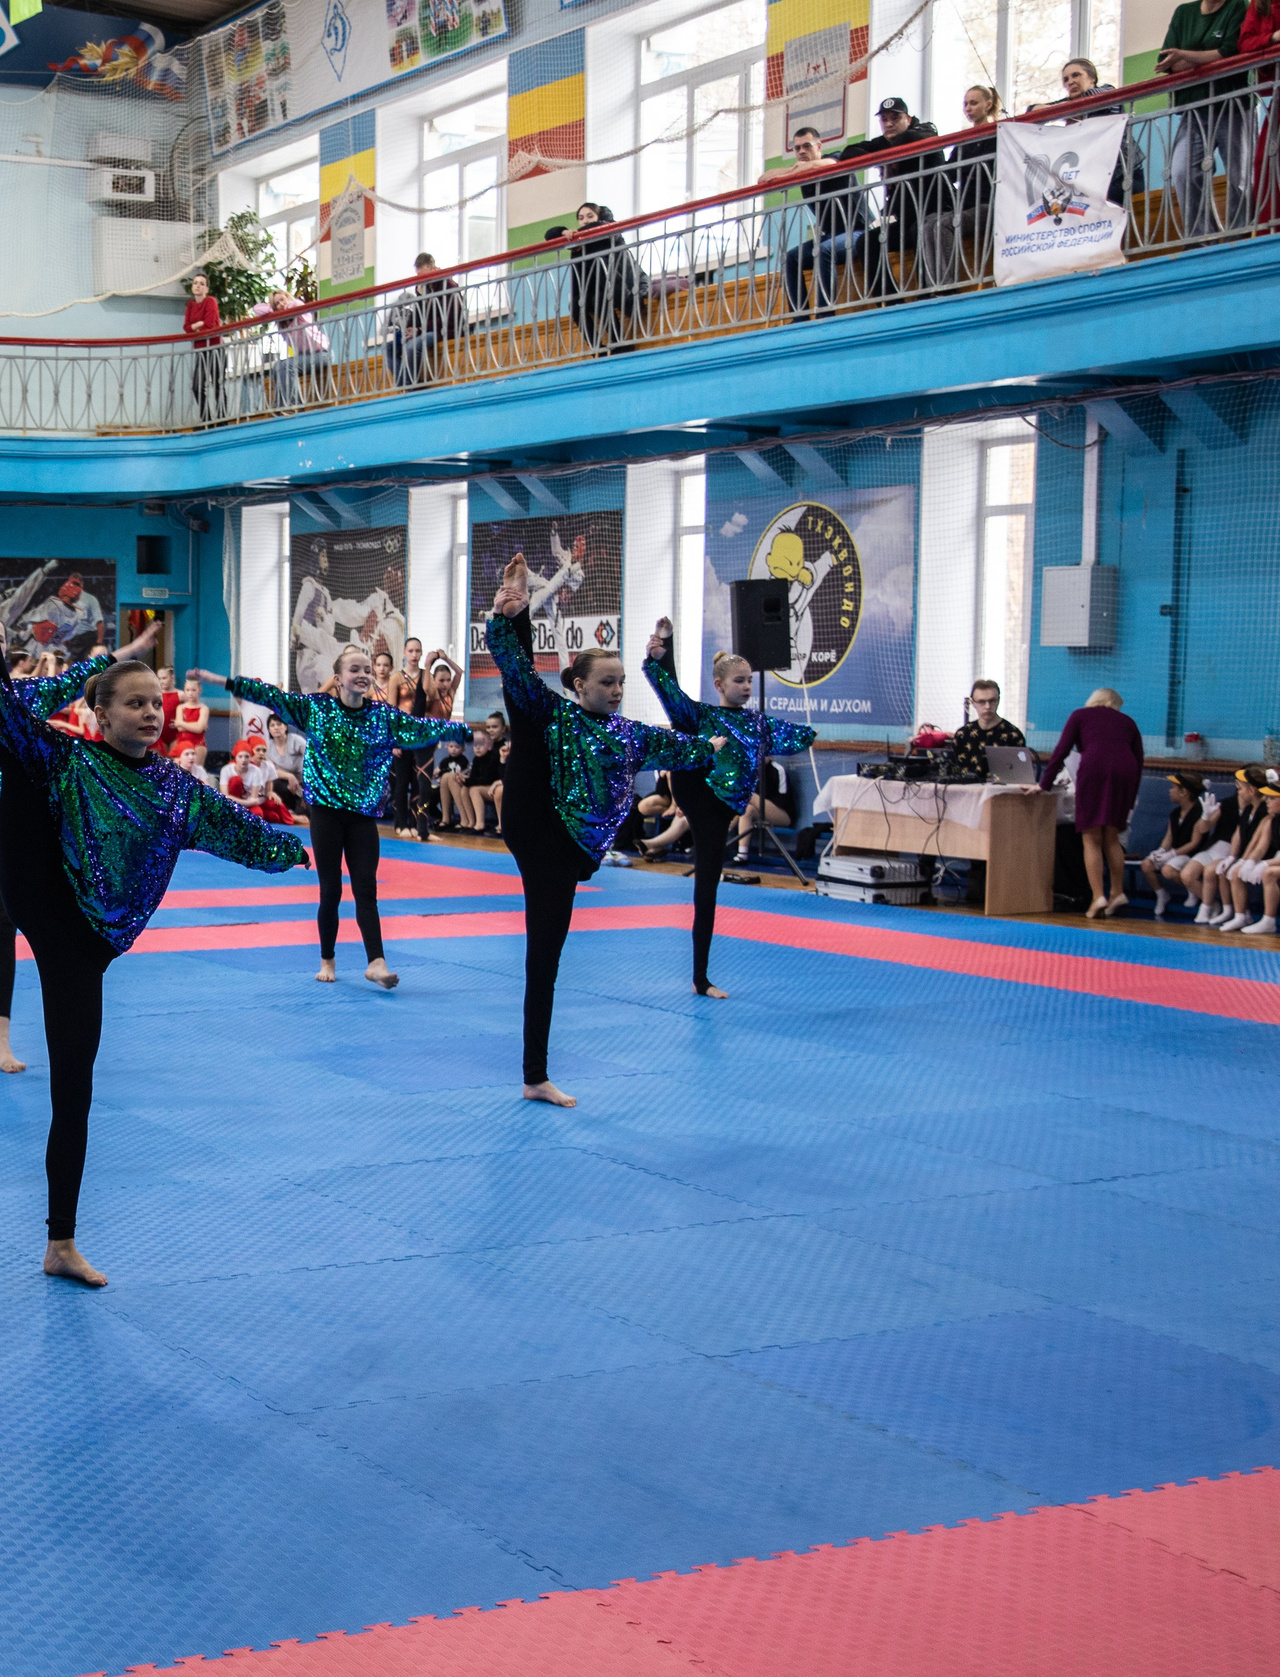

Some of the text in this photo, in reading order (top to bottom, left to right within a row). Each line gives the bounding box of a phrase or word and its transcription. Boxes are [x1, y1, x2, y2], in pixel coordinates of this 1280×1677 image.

[1000, 231, 1113, 258] РОССИЙСКОЙ ФЕДЕРАЦИИ
[1004, 219, 1113, 244] МИНИСТЕРСТВО СПОРТА
[807, 515, 855, 629] ТХЭКВОНДО
[538, 620, 583, 649] Dado
[811, 649, 837, 663] КОРЁ
[829, 698, 872, 713] ДУХОМ
